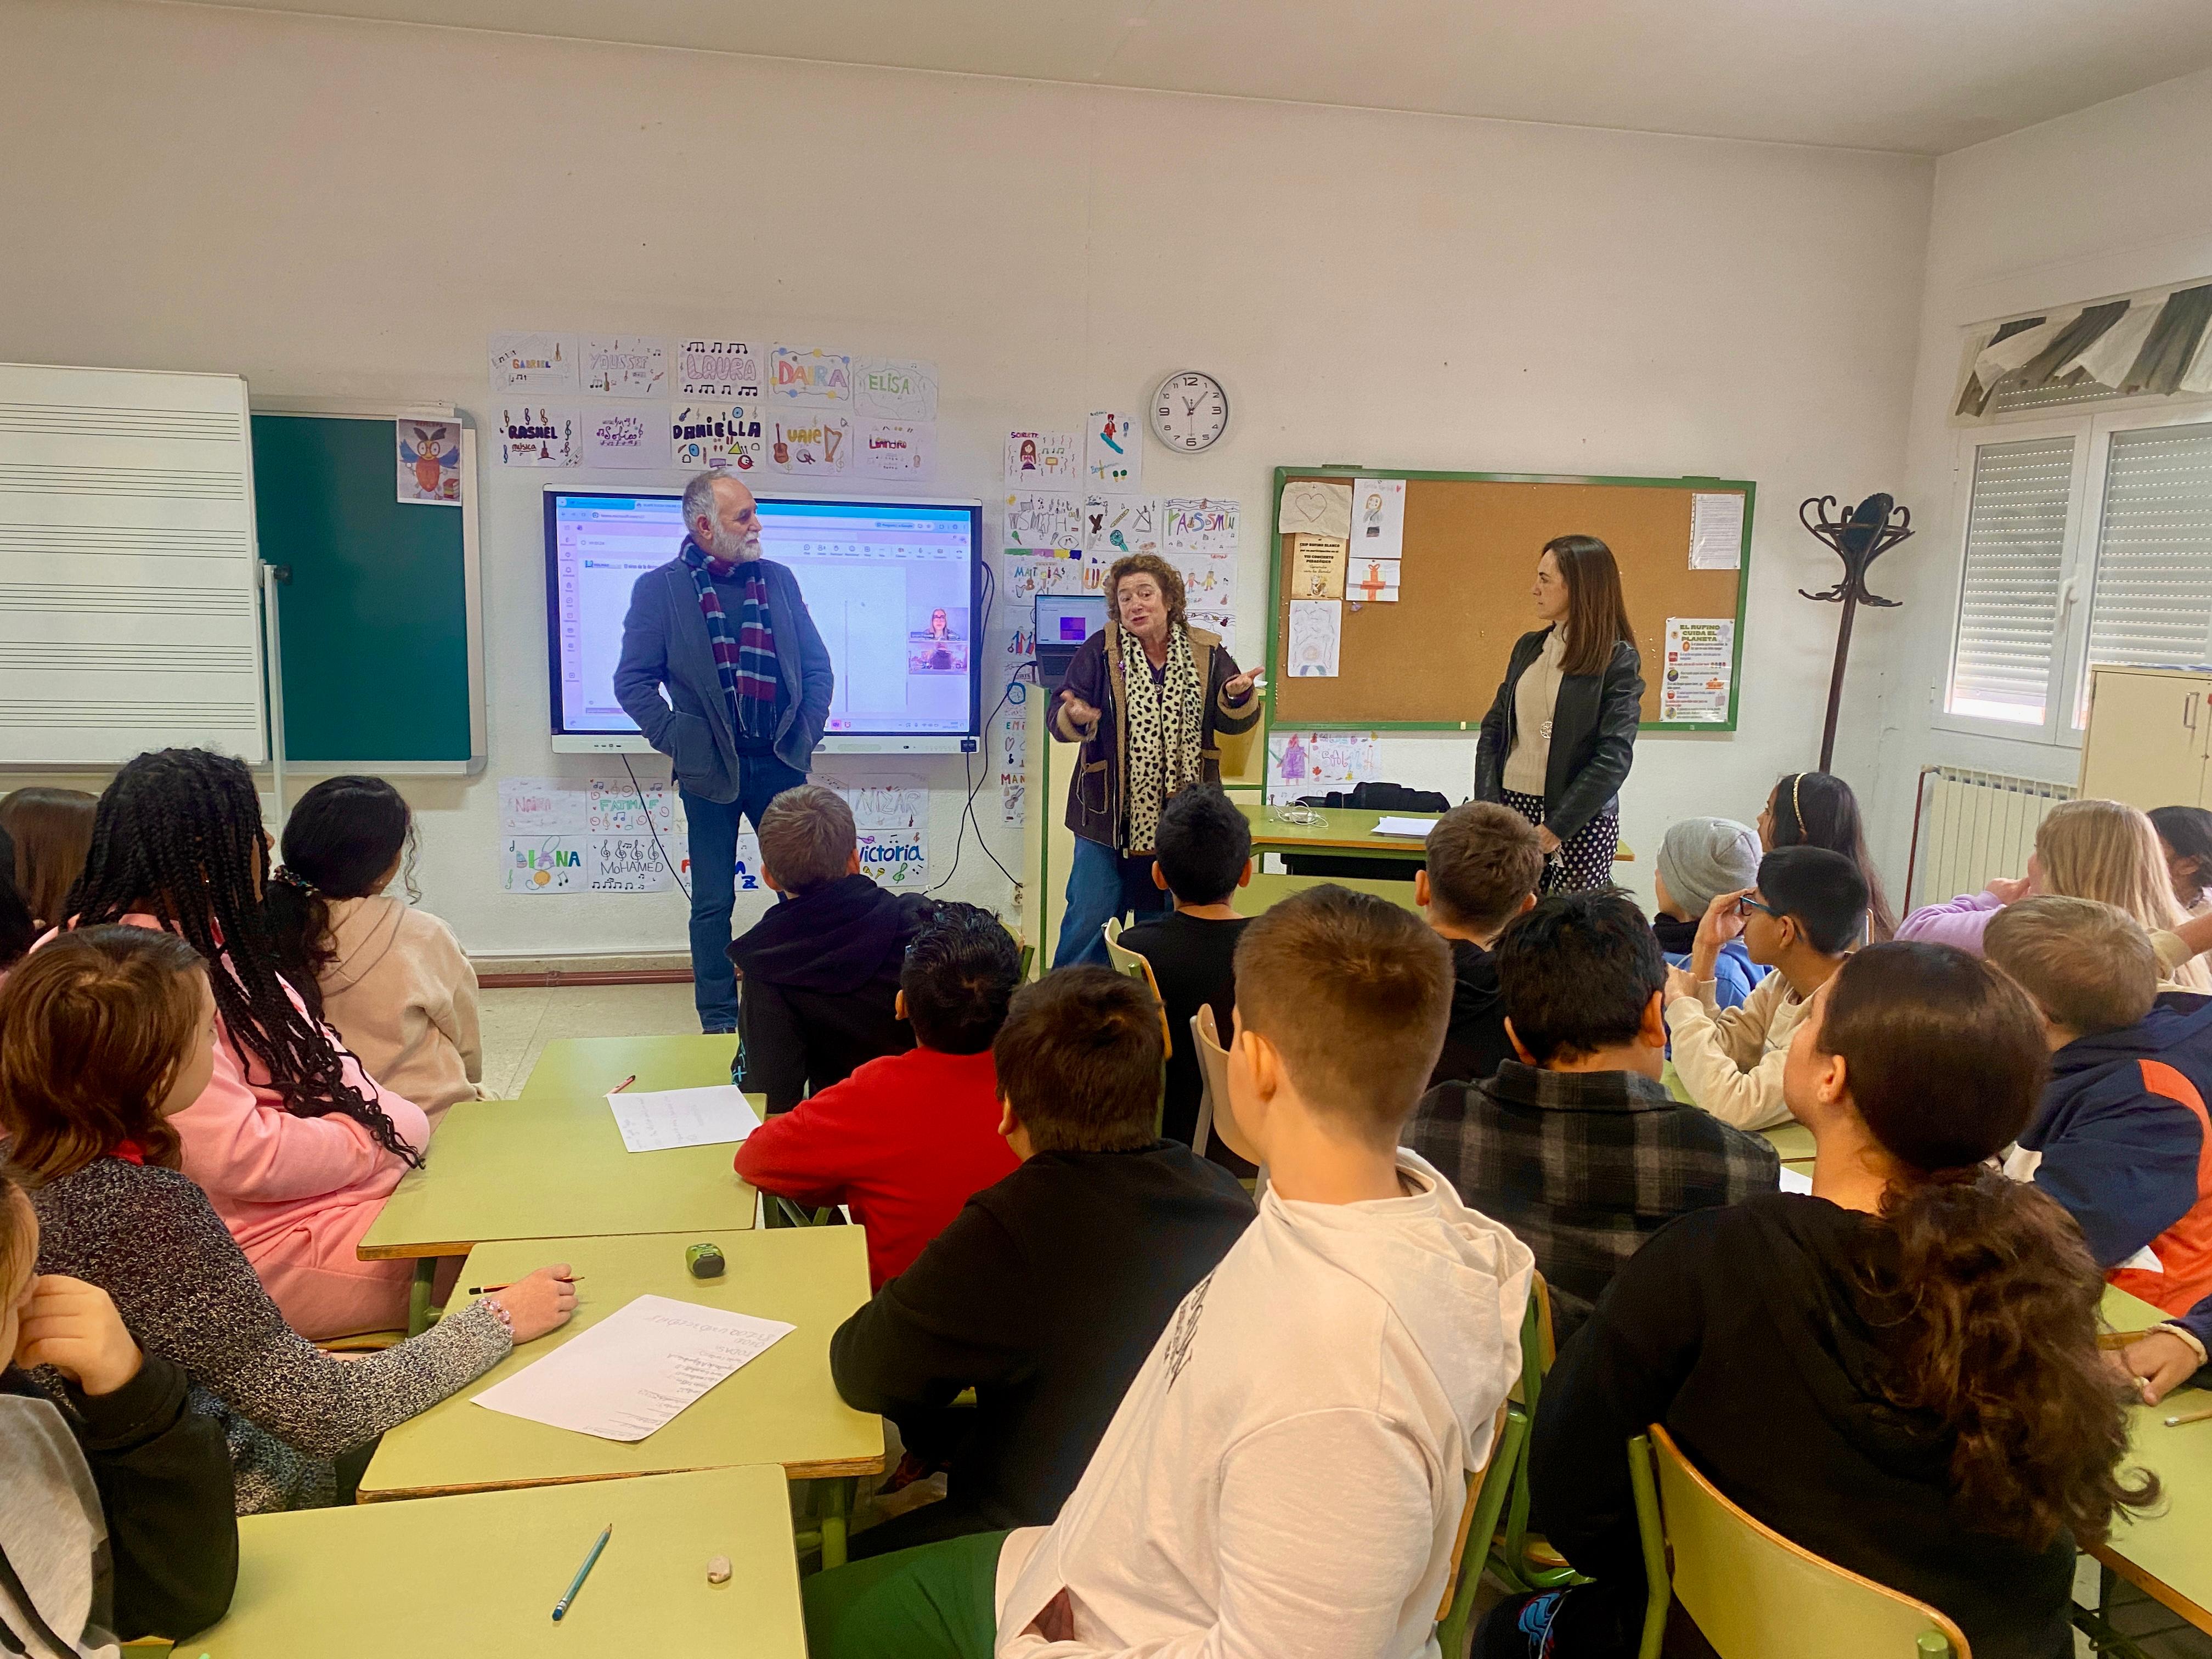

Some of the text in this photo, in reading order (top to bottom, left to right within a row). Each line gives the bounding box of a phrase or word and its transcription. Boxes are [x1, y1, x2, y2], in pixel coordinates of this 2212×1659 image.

[686, 354, 756, 381] LAURA
[779, 360, 847, 387] DAIRA
[1183, 377, 1198, 386] 12
[1159, 407, 1170, 416] 9
[1211, 407, 1222, 415] 3
[1186, 438, 1197, 446] 6
[855, 791, 921, 816] NIZAR
[516, 850, 581, 868] DIANA
